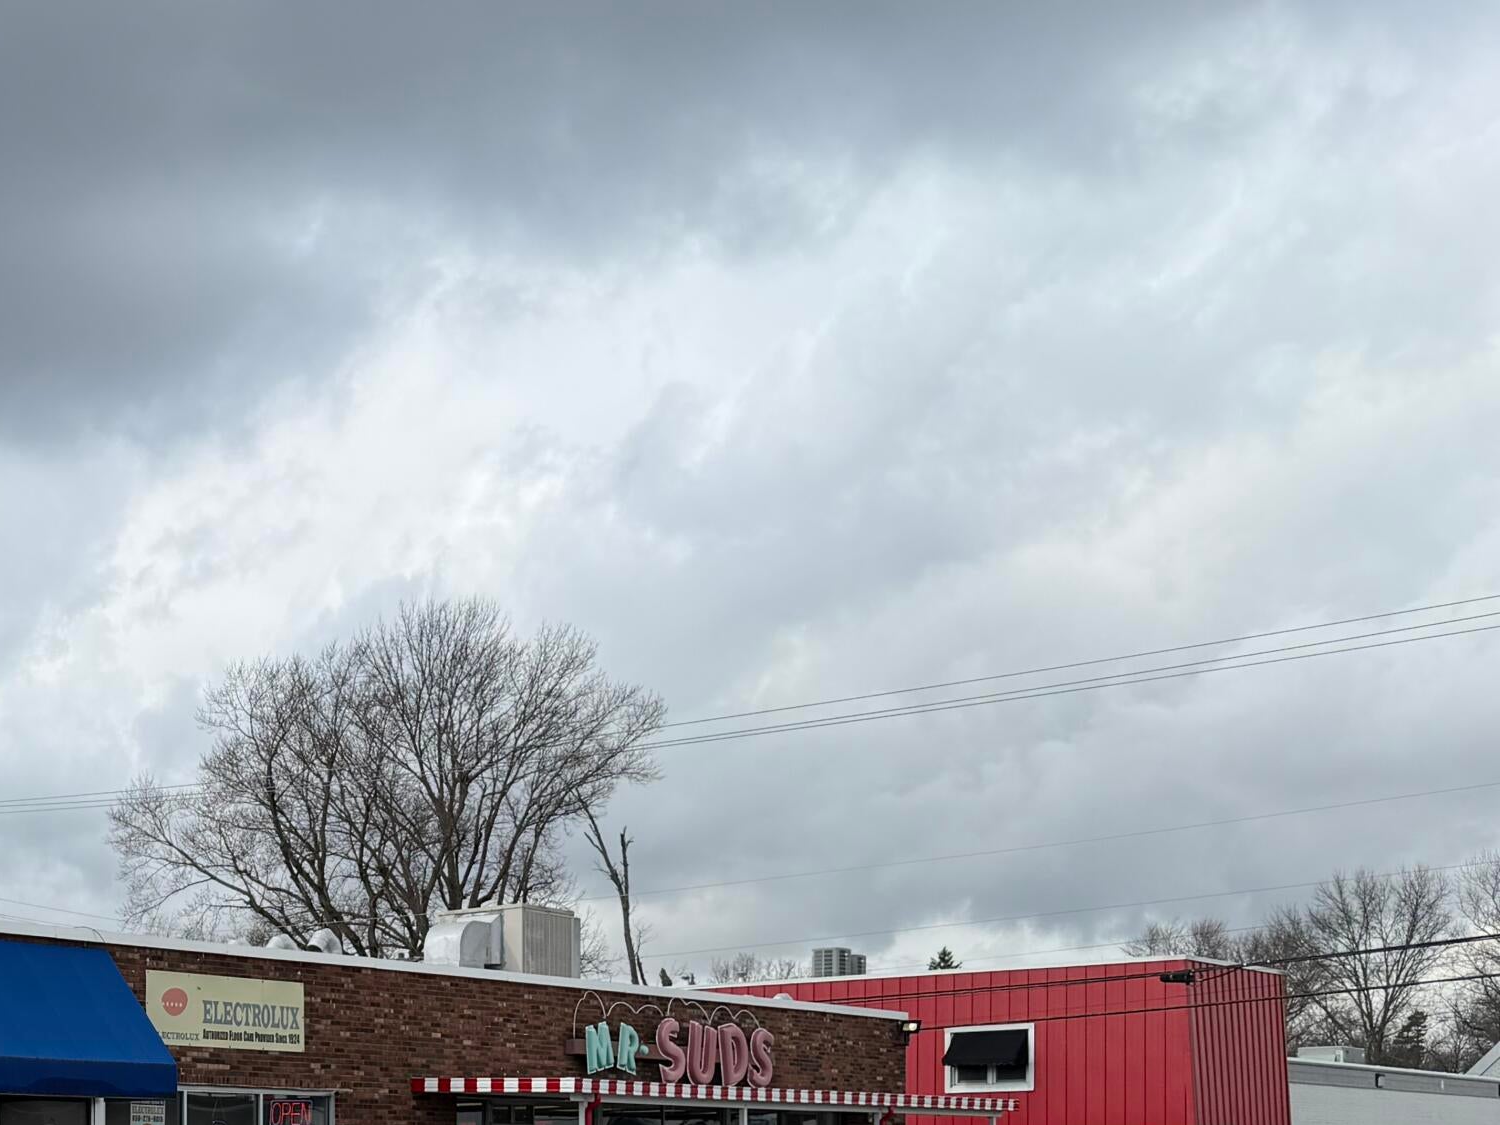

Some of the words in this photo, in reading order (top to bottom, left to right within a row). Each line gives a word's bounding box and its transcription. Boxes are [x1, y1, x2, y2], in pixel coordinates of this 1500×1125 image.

[202, 1000, 300, 1030] ELECTROLUX
[161, 1031, 200, 1041] ECTROLUX
[656, 1018, 774, 1089] SUDS
[271, 1103, 312, 1125] OPEN
